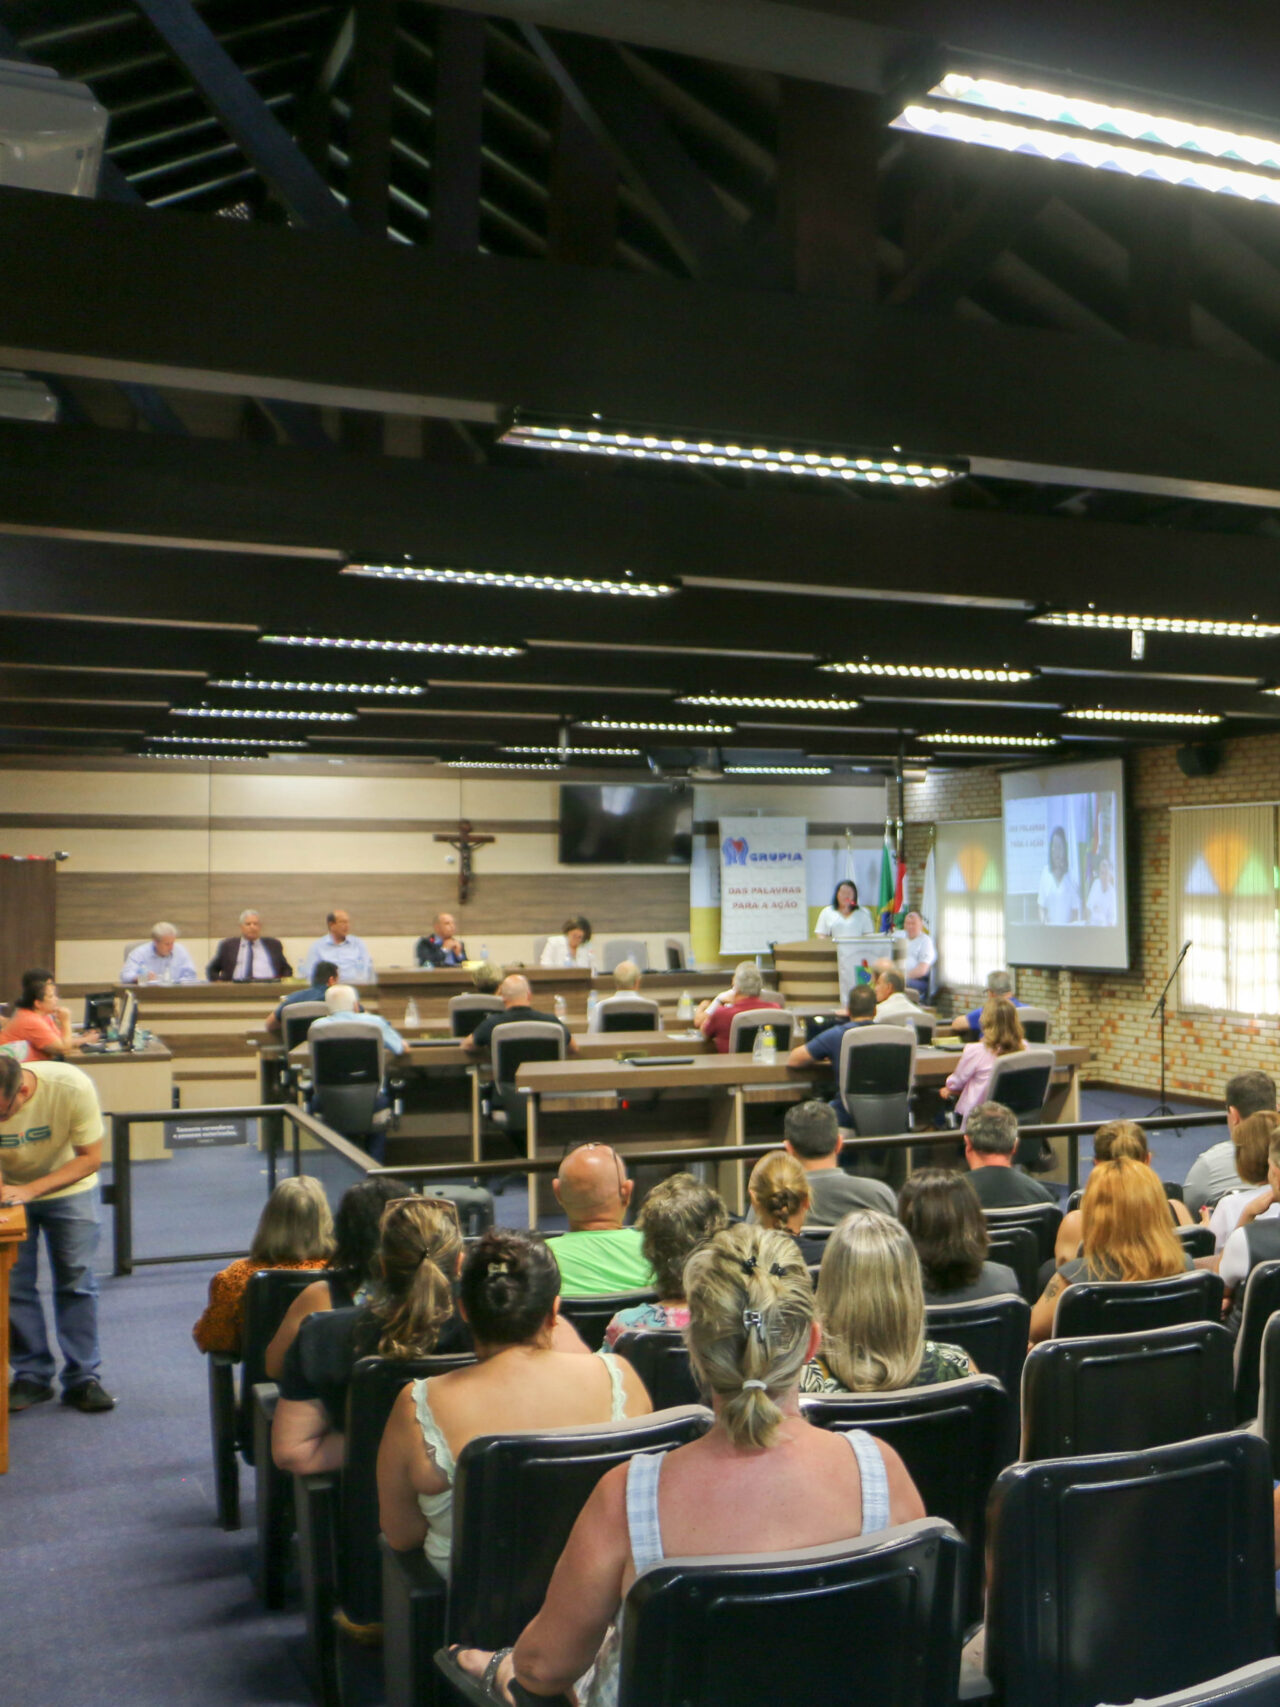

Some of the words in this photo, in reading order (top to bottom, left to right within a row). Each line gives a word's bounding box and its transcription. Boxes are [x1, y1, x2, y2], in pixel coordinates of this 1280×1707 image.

[749, 852, 803, 862] GRUPIA
[728, 887, 748, 896] DAS
[751, 886, 802, 895] PALAVRAS
[761, 901, 768, 909] A
[771, 900, 798, 910] AÇÃO
